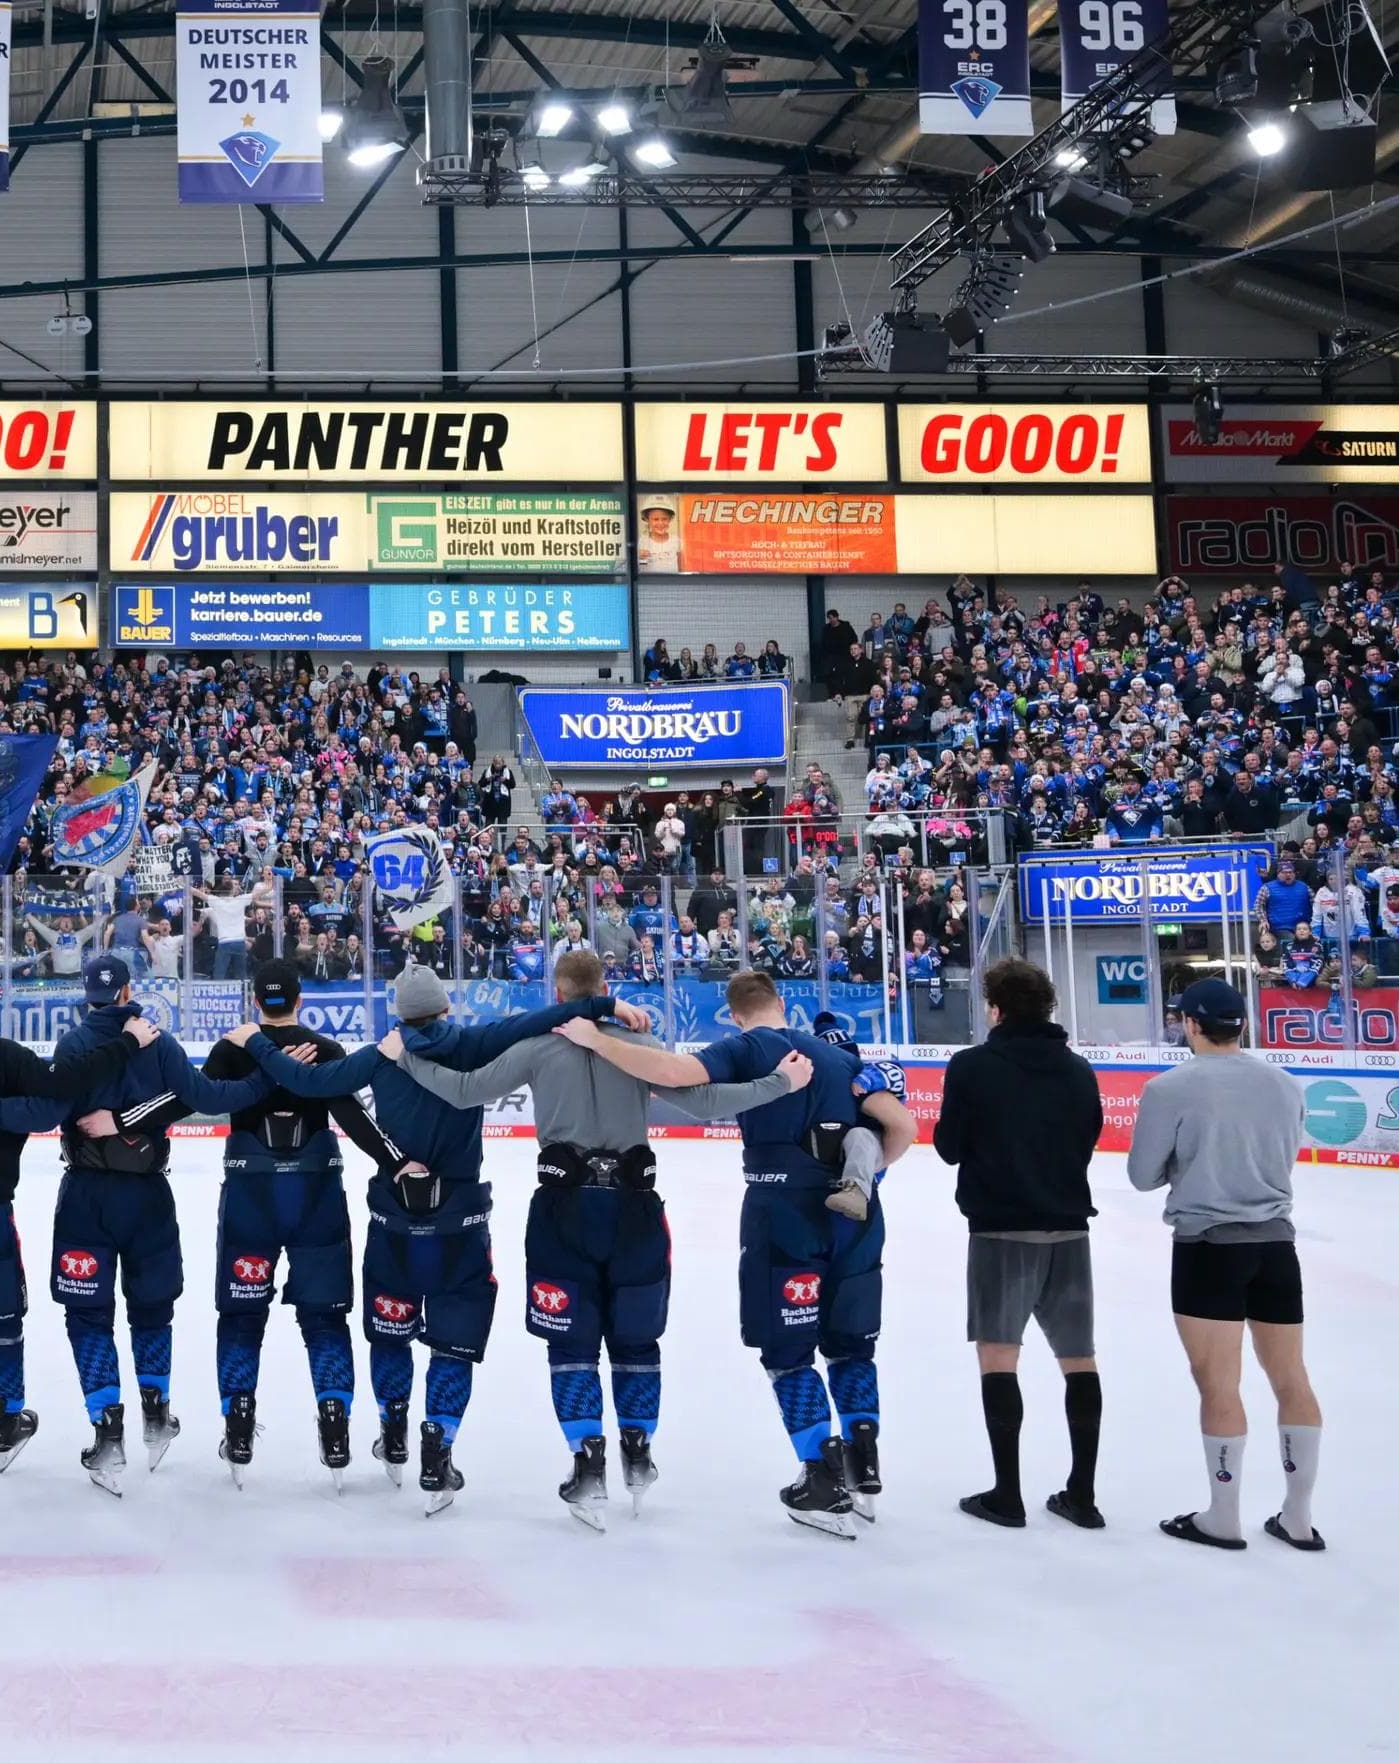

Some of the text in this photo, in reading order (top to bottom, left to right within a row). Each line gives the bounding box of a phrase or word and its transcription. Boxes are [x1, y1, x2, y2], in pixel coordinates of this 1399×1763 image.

[214, 1, 280, 9] INGOLSTADT
[943, 0, 1007, 50] 38
[1079, 0, 1144, 50] 96
[188, 28, 308, 46] DEUTSCHER
[200, 53, 298, 71] MEISTER
[957, 62, 993, 73] ERC
[208, 78, 290, 104] 2014
[207, 411, 509, 472] PANTHER
[682, 412, 1125, 474] LET'S GOOO!
[1343, 440, 1396, 457] SATURN
[176, 494, 251, 515] MÖBEL
[446, 496, 492, 510] EISZEIT
[496, 498, 517, 511] gibt
[520, 500, 532, 510] es
[535, 500, 552, 510] nur
[569, 498, 587, 510] der
[590, 498, 621, 510] Arena
[690, 501, 885, 524] HECHINGER
[446, 518, 621, 536] Heizöl und Kraftstoffe
[172, 506, 339, 570] gruber
[1178, 507, 1329, 567] radio
[381, 549, 434, 560] GUNVOR
[446, 540, 622, 557] direkt vom Hersteller
[713, 551, 865, 559] ENTSORGUNG CONTAINERDIENST
[190, 591, 311, 605] Jetzt bewerben!
[428, 587, 573, 605] GEBRÜDER
[190, 609, 323, 622] karriere.bauer.de
[428, 610, 575, 634] PETERS
[120, 626, 171, 640] BAUER
[190, 632, 362, 643] Spezialtiefbau Maschinen Resources
[382, 636, 428, 646] Ingolstadt
[434, 636, 475, 646] München
[481, 636, 525, 647] Nürnberg
[577, 636, 621, 646] Heilbronn
[559, 710, 742, 745] NORDBRÄU
[607, 746, 695, 759] INGOLSTADT
[145, 844, 172, 855] MATTER
[136, 855, 155, 864] WHAT
[373, 853, 424, 890] 64
[1050, 870, 1240, 904] NORDBRÄU
[1102, 961, 1146, 981] WC
[474, 983, 504, 1009] 64
[1116, 1051, 1146, 1061] Audi
[1301, 1054, 1334, 1064] Audi
[56, 1275, 99, 1289] Backhaus
[58, 1283, 96, 1296] Hackner
[530, 1306, 572, 1324] Backhaus
[531, 1315, 570, 1332] Hackner
